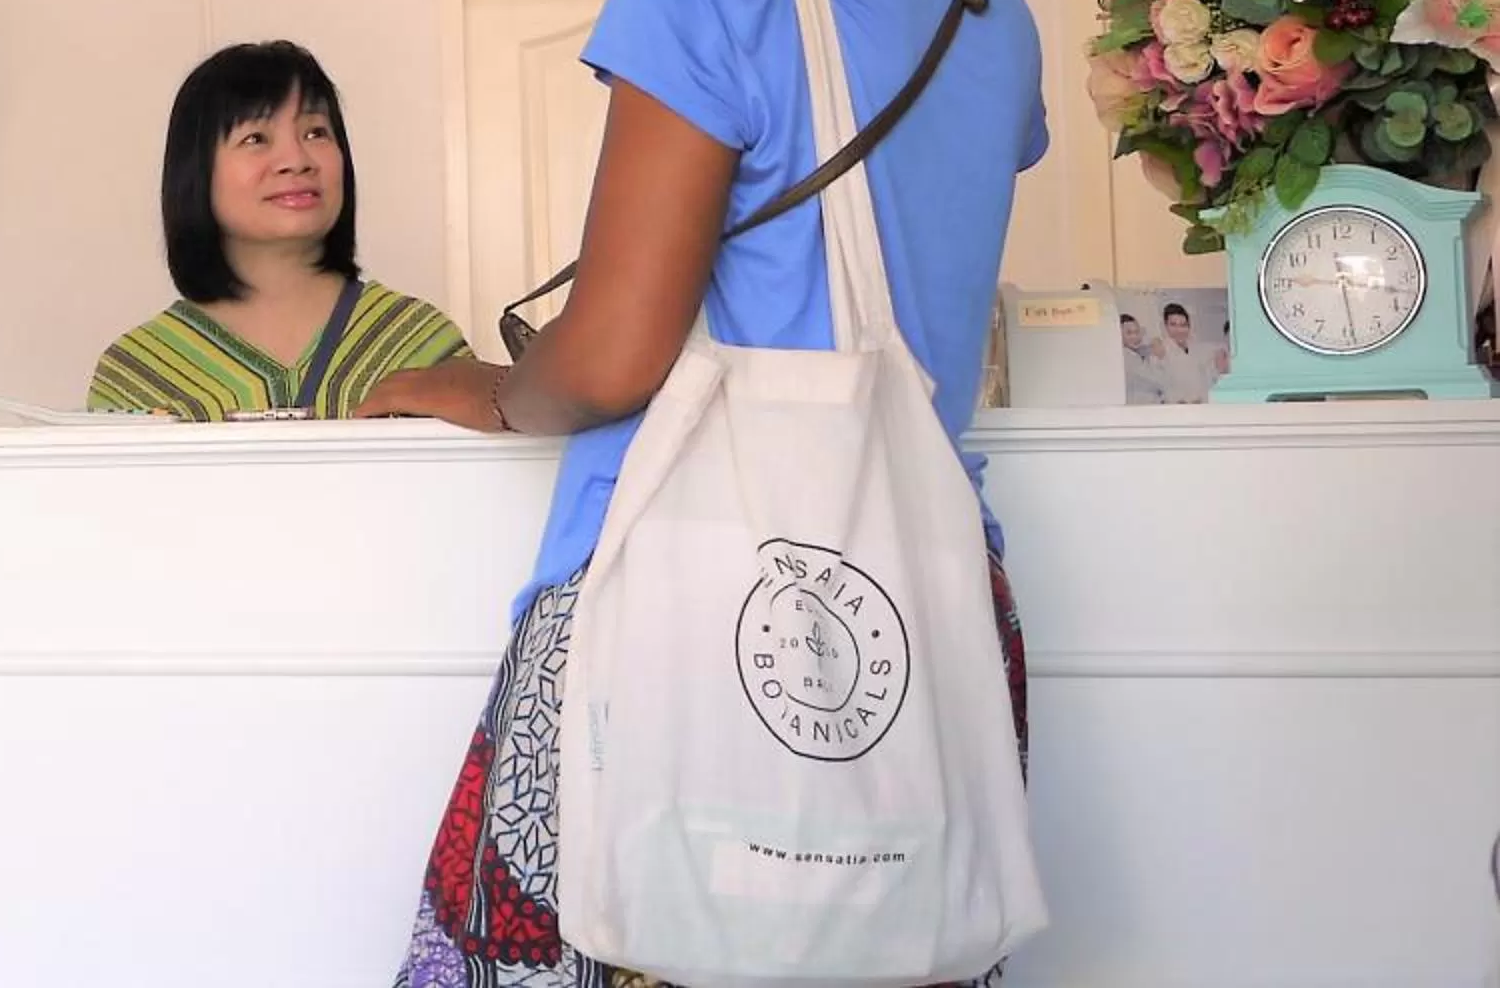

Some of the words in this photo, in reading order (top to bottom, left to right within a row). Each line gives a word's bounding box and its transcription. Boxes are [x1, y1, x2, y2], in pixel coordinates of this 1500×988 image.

[1332, 223, 1352, 240] 12
[1307, 232, 1321, 249] 11
[1289, 252, 1307, 268] 10
[1384, 245, 1398, 260] 2
[1292, 303, 1305, 317] 8
[1315, 319, 1326, 334] 7
